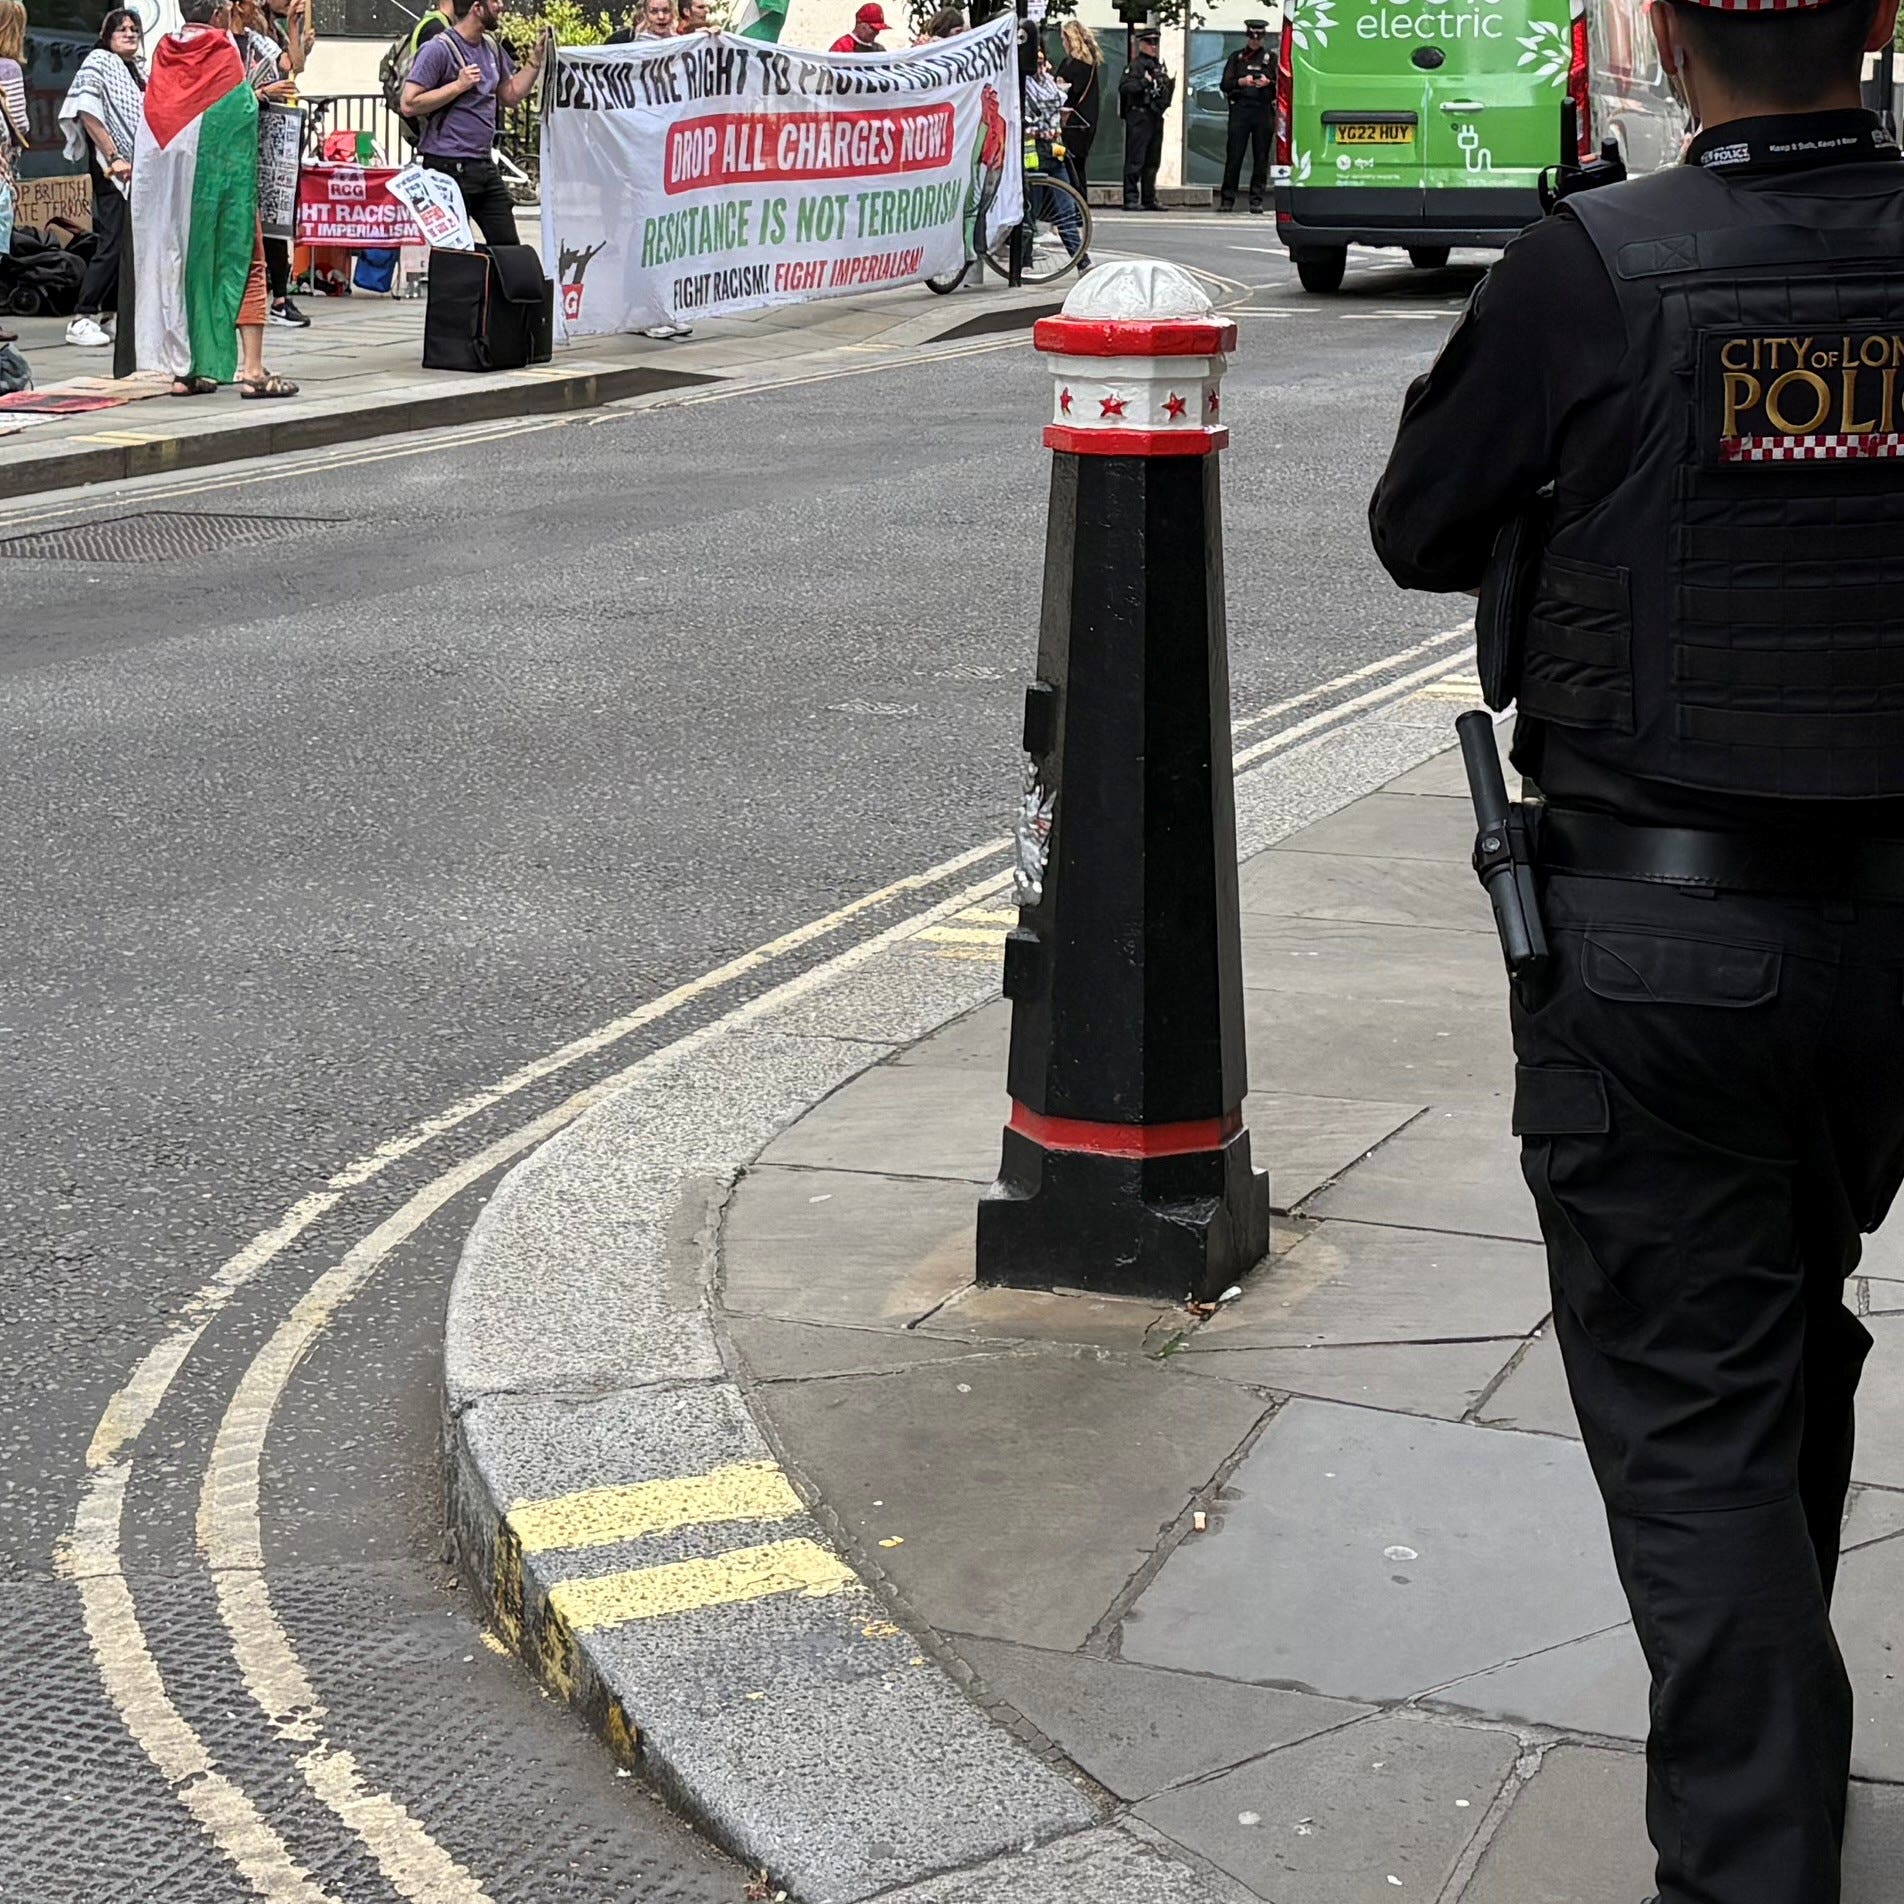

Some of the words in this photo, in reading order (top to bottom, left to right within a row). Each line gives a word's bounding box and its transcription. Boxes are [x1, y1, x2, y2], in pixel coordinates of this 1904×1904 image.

[1356, 7, 1503, 39] electric
[557, 60, 636, 111] DEFEND
[640, 54, 682, 107] THE
[681, 47, 749, 101] RIGHT
[756, 49, 791, 96] TO
[924, 28, 1011, 86] PALESTIN
[671, 126, 717, 184] DROP
[721, 123, 767, 174] ALL
[777, 117, 897, 171] CHARGES
[900, 111, 950, 162] NOW!
[1338, 125, 1376, 140] YG22
[1379, 124, 1410, 139] HUY
[35, 179, 87, 201] BRITISH
[330, 183, 364, 197] RCG
[318, 222, 419, 238] IMPERIALISM
[641, 199, 753, 268] RESISTANCE
[758, 197, 788, 245] IS
[796, 194, 849, 243] NOT
[856, 177, 963, 238] TERRORISM
[673, 271, 711, 312] FIGHT
[713, 263, 770, 303] RACISM!
[775, 259, 829, 292] FIGHT
[829, 246, 925, 288] IMPERIALISM!
[1720, 337, 1813, 370] CITY
[1811, 351, 1839, 369] OF
